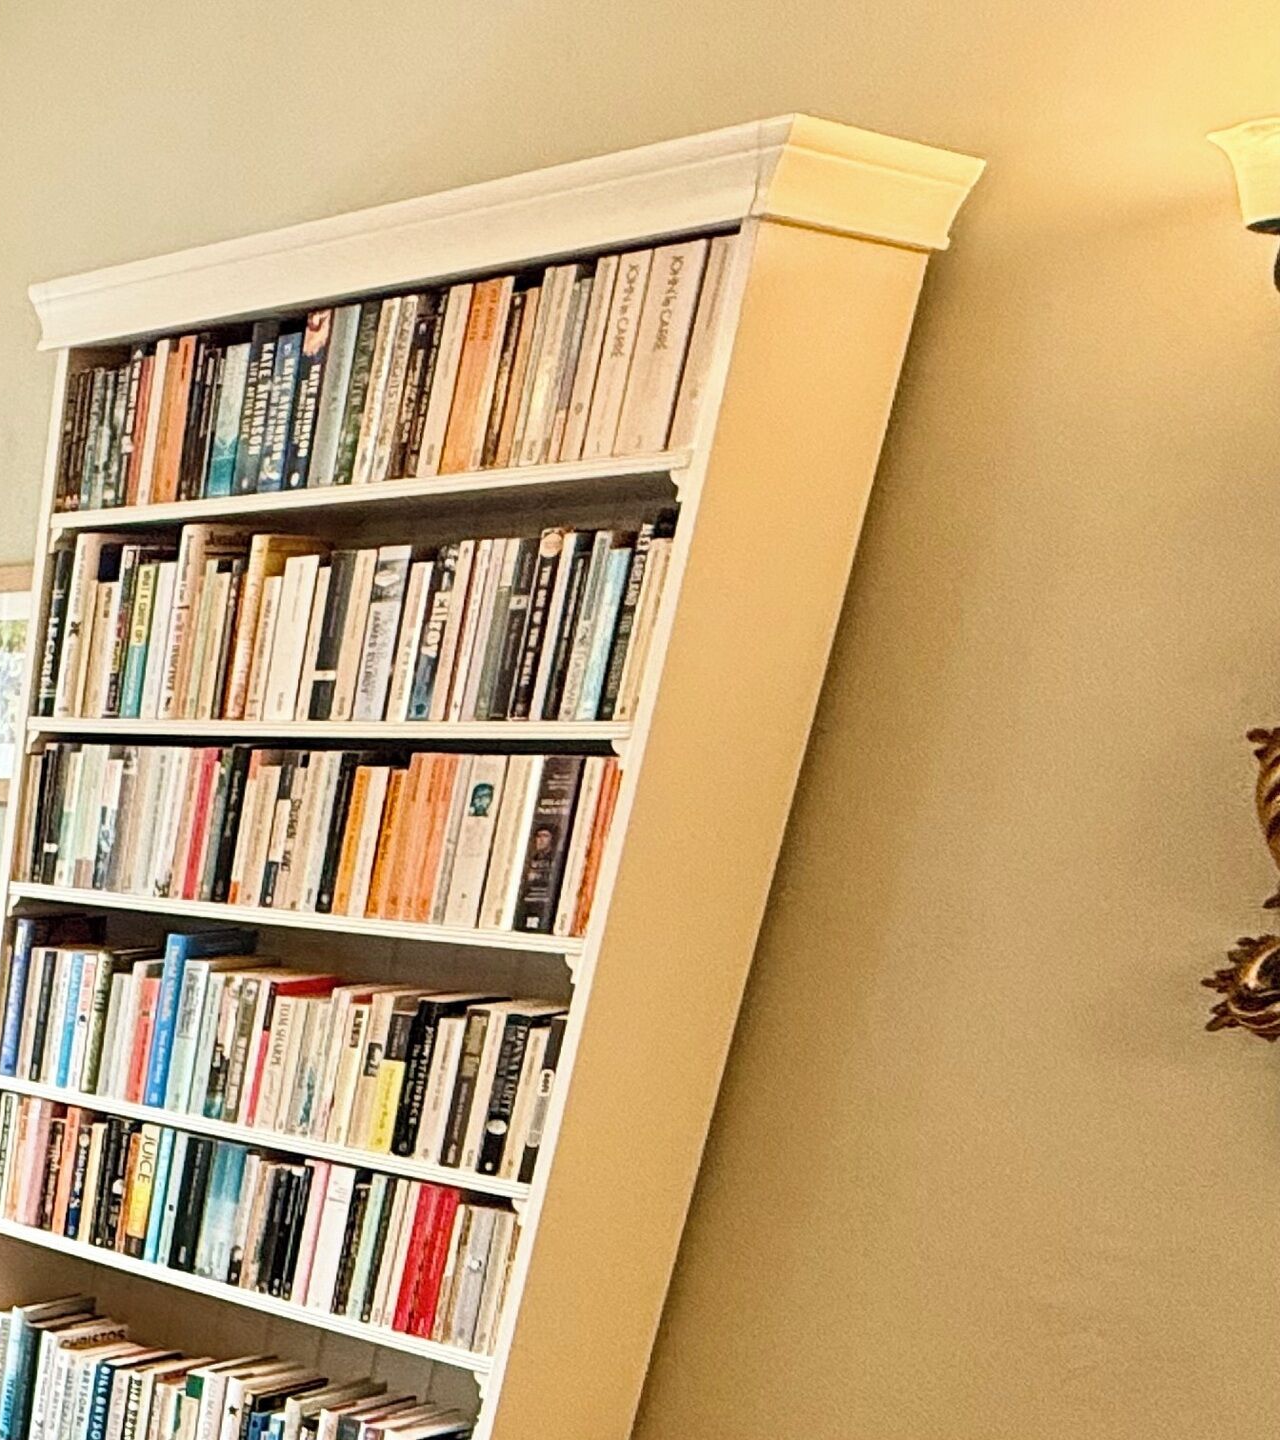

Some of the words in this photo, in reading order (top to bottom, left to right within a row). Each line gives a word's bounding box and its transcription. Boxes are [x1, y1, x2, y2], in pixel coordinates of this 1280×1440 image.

[623, 264, 640, 302] JOHN
[664, 256, 685, 295] JOHN
[259, 342, 275, 379] KATE
[280, 357, 295, 392] KATE
[306, 363, 322, 395] KATE
[247, 384, 270, 455] ATKINSON
[271, 399, 290, 461] ATKINSON
[297, 398, 317, 458] ATKINSON
[636, 523, 654, 550] ALEX
[624, 553, 647, 606] GARLAND
[368, 610, 382, 648] JAMES
[421, 590, 451, 658] Ellroy
[360, 651, 377, 695] ELLROY
[286, 797, 304, 841] STEPHEN
[277, 1003, 291, 1027] TOM
[271, 1028, 288, 1068] SHARPE
[421, 1026, 435, 1056] JOHN
[408, 1057, 430, 1127] STEINBECK
[499, 1072, 521, 1115] TARTT
[137, 1134, 157, 1184] JUICE
[78, 1368, 91, 1414] BRYSON
[98, 1365, 111, 1395] BILL
